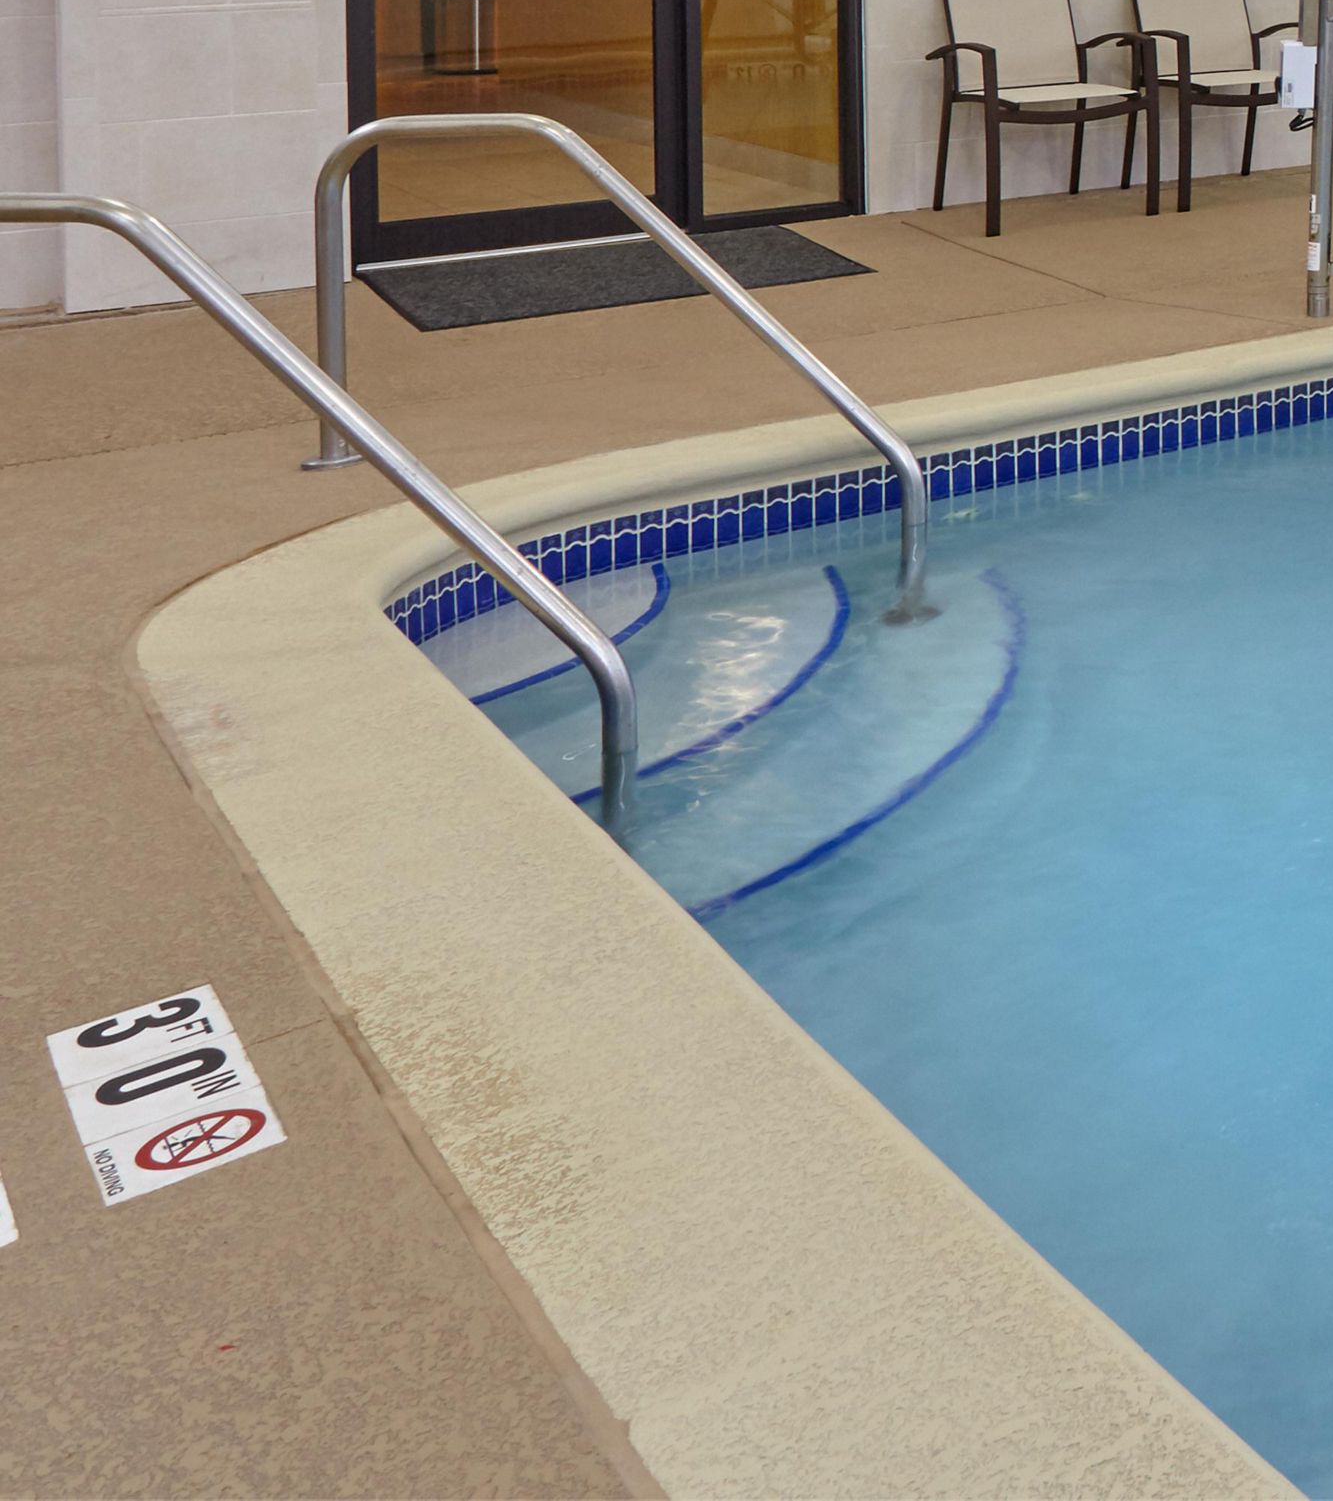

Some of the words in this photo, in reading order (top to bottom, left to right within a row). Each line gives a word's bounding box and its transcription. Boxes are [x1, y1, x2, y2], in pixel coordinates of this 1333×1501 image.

[77, 997, 201, 1048] 3
[166, 1017, 214, 1043] FT
[95, 1047, 227, 1106] 0
[191, 1069, 241, 1100] IN
[93, 1148, 113, 1164] NO
[99, 1163, 125, 1197] DIVING
